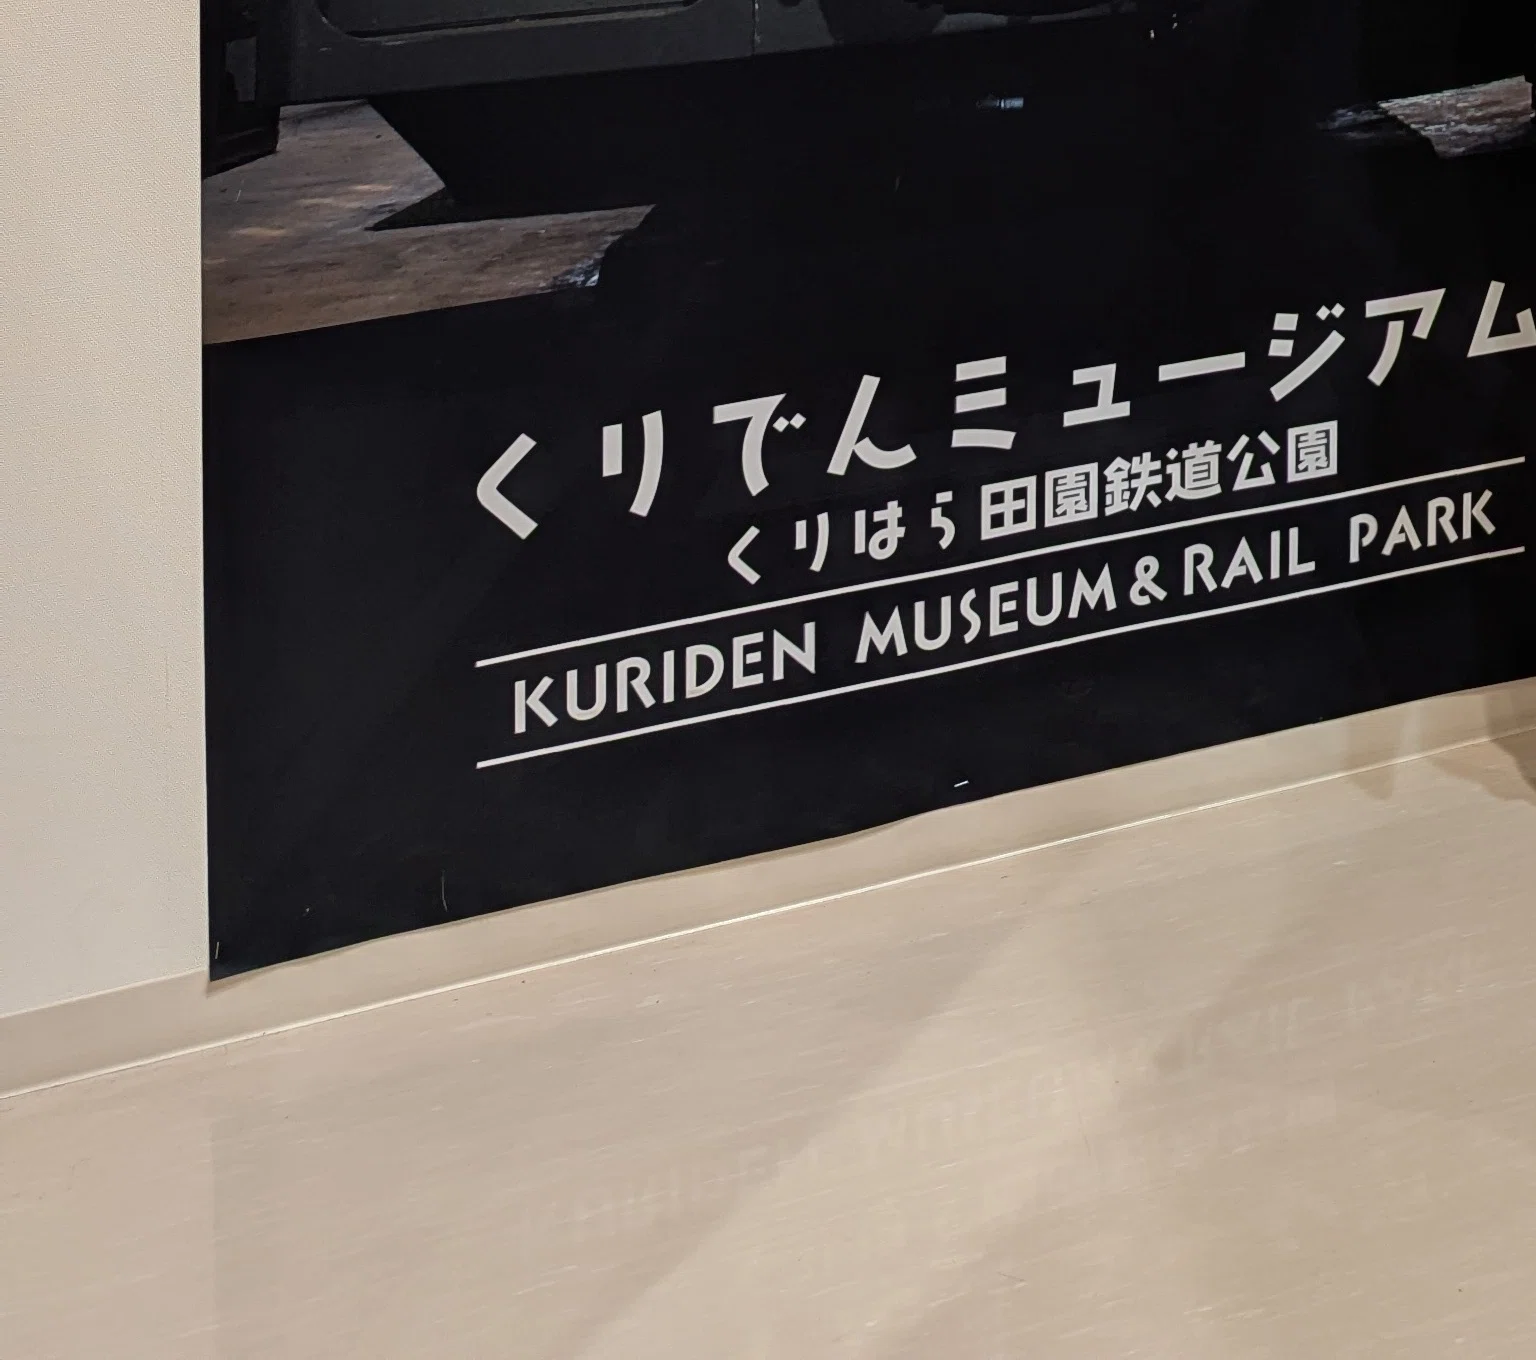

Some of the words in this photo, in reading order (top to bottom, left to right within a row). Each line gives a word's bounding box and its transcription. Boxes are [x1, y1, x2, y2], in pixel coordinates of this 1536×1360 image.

[727, 419, 1338, 585] くりはら田園鉄道公園
[514, 621, 816, 735] KURIDEN
[855, 562, 1117, 664] MUSEUM
[1183, 526, 1316, 596] RAIL
[1349, 489, 1496, 564] PARK
